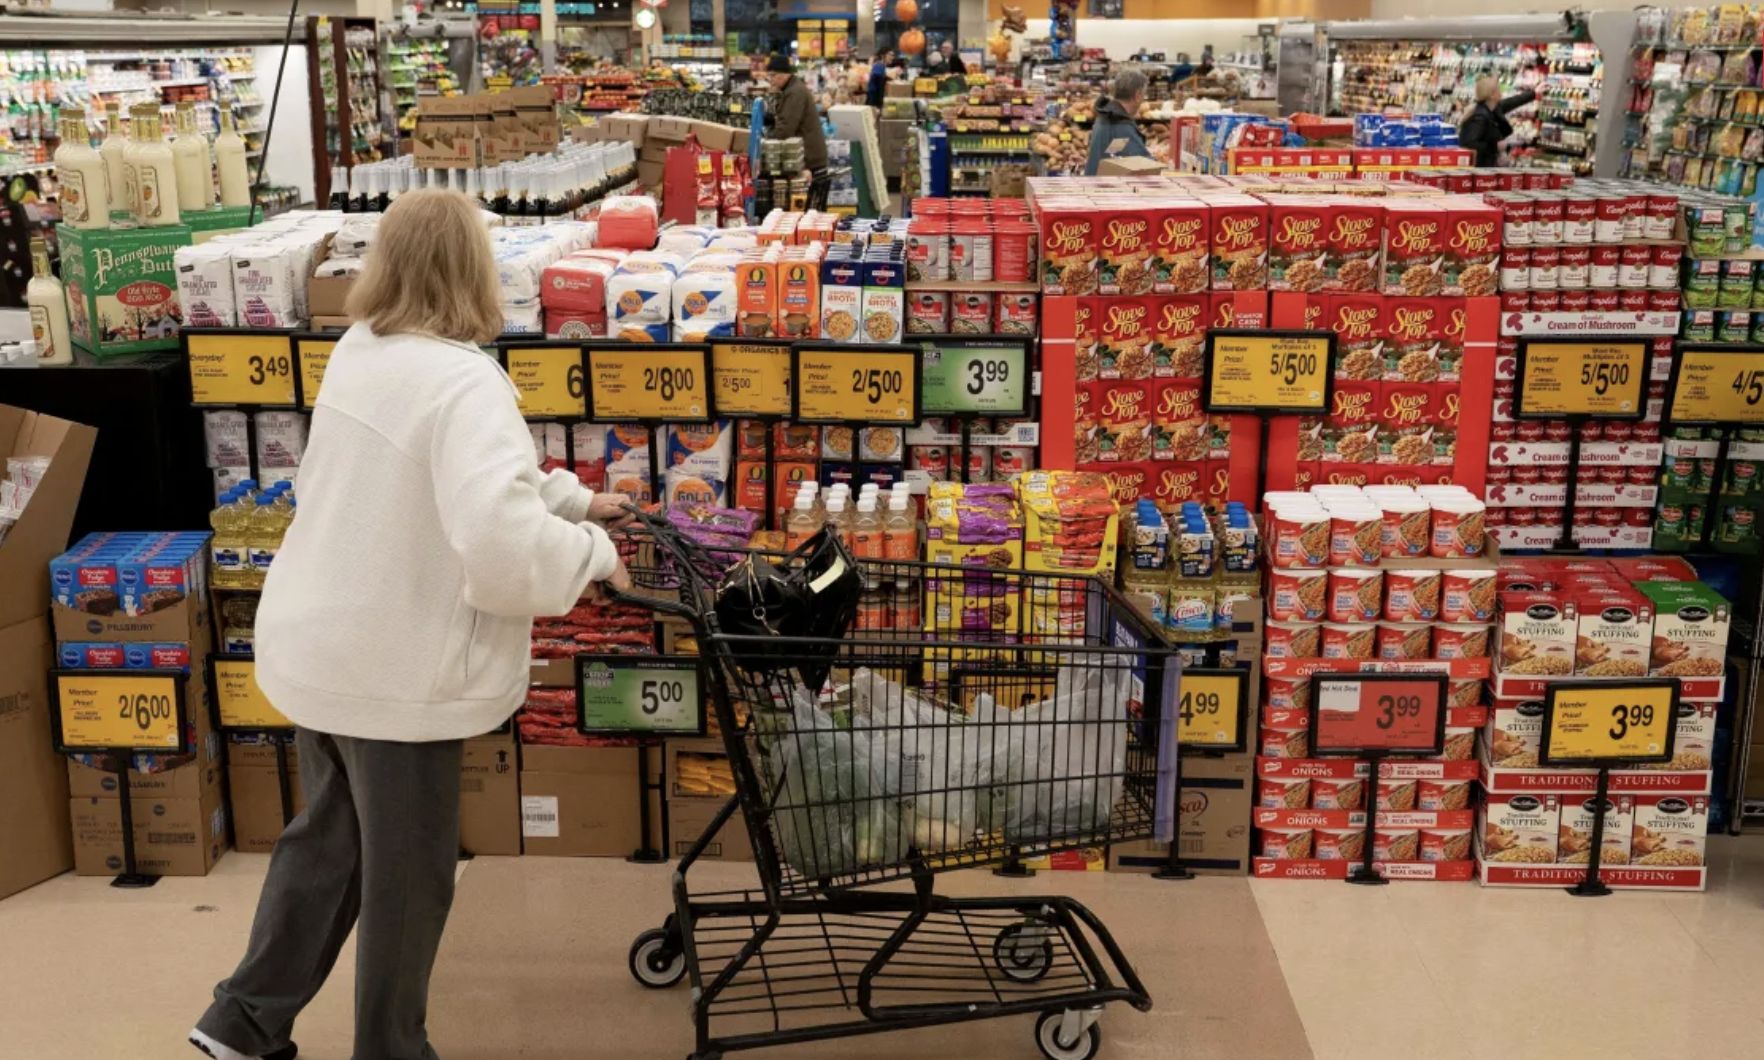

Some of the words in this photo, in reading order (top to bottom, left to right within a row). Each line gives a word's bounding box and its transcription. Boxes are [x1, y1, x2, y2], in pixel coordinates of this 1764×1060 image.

[1046, 220, 1092, 248] Stove
[1103, 219, 1147, 247] Stove
[1157, 217, 1201, 245] Stove
[1215, 215, 1259, 244] Stove
[1276, 216, 1321, 242] Stove
[1329, 215, 1374, 241] Stove
[1392, 220, 1436, 247] Stove
[1449, 220, 1494, 248] Stove
[1062, 236, 1085, 253] Top
[1118, 236, 1140, 253] Top
[1174, 233, 1196, 251] Top
[1231, 231, 1253, 249] Top
[1291, 231, 1314, 248] Top
[1345, 230, 1367, 248] Top
[1407, 236, 1429, 253] Top
[1465, 236, 1487, 254] Top
[94, 243, 183, 289] Pennsylvani
[142, 260, 173, 274] Dut
[827, 295, 856, 303] BROTH
[1103, 305, 1147, 333] Stove
[1157, 304, 1200, 331] Stove
[1332, 306, 1378, 333] Stove
[1388, 307, 1434, 334] Stove
[1548, 321, 1577, 330] Cream
[1578, 320, 1587, 330] of
[1589, 320, 1636, 330] Mushroom
[1118, 321, 1140, 338] Top
[1174, 320, 1195, 337] Top
[1349, 322, 1371, 339] Top
[1404, 323, 1428, 340] Top
[249, 356, 289, 385] 349
[966, 359, 1010, 395] 399
[1270, 353, 1317, 385] 5/500
[643, 367, 694, 401] 2/800
[722, 377, 751, 393] 2/500
[852, 370, 902, 404] 2/500
[1580, 363, 1629, 395] 5/500
[1102, 389, 1145, 416] Stove
[1157, 388, 1199, 414] Stove
[1331, 390, 1372, 416] Stove
[1384, 392, 1428, 419] Stove
[1117, 404, 1139, 421] Top
[1173, 403, 1194, 421] Top
[1344, 407, 1365, 422] Top
[1400, 409, 1421, 424] Top
[1532, 453, 1560, 462] Cream
[1579, 453, 1620, 462] ushroom
[1156, 470, 1198, 496] Stove
[677, 491, 712, 501] GOLD
[1171, 485, 1192, 501] Top
[1530, 493, 1558, 502] Cream
[1575, 493, 1615, 502] ushroom
[1524, 536, 1551, 545] Cream
[1516, 627, 1565, 636] STUFFING
[1591, 630, 1639, 639] STUFFING
[1666, 629, 1716, 638] STUFFING
[642, 681, 683, 715] 500
[119, 694, 170, 730] 2/600
[1179, 692, 1219, 727] 499
[1376, 695, 1421, 730] 399
[1609, 704, 1654, 741] 399
[496, 763, 510, 774] UP
[1292, 767, 1333, 776] ONIONS
[1520, 776, 1594, 785] TRADITION
[1616, 776, 1680, 785] STUFFING
[1287, 817, 1328, 825] ONIONS
[1573, 821, 1620, 829] STUING
[1648, 821, 1695, 829] STUFFING
[1286, 867, 1326, 876] ONIONS
[1513, 869, 1601, 880] TRADITIONL
[1609, 871, 1675, 881] STUFFING
